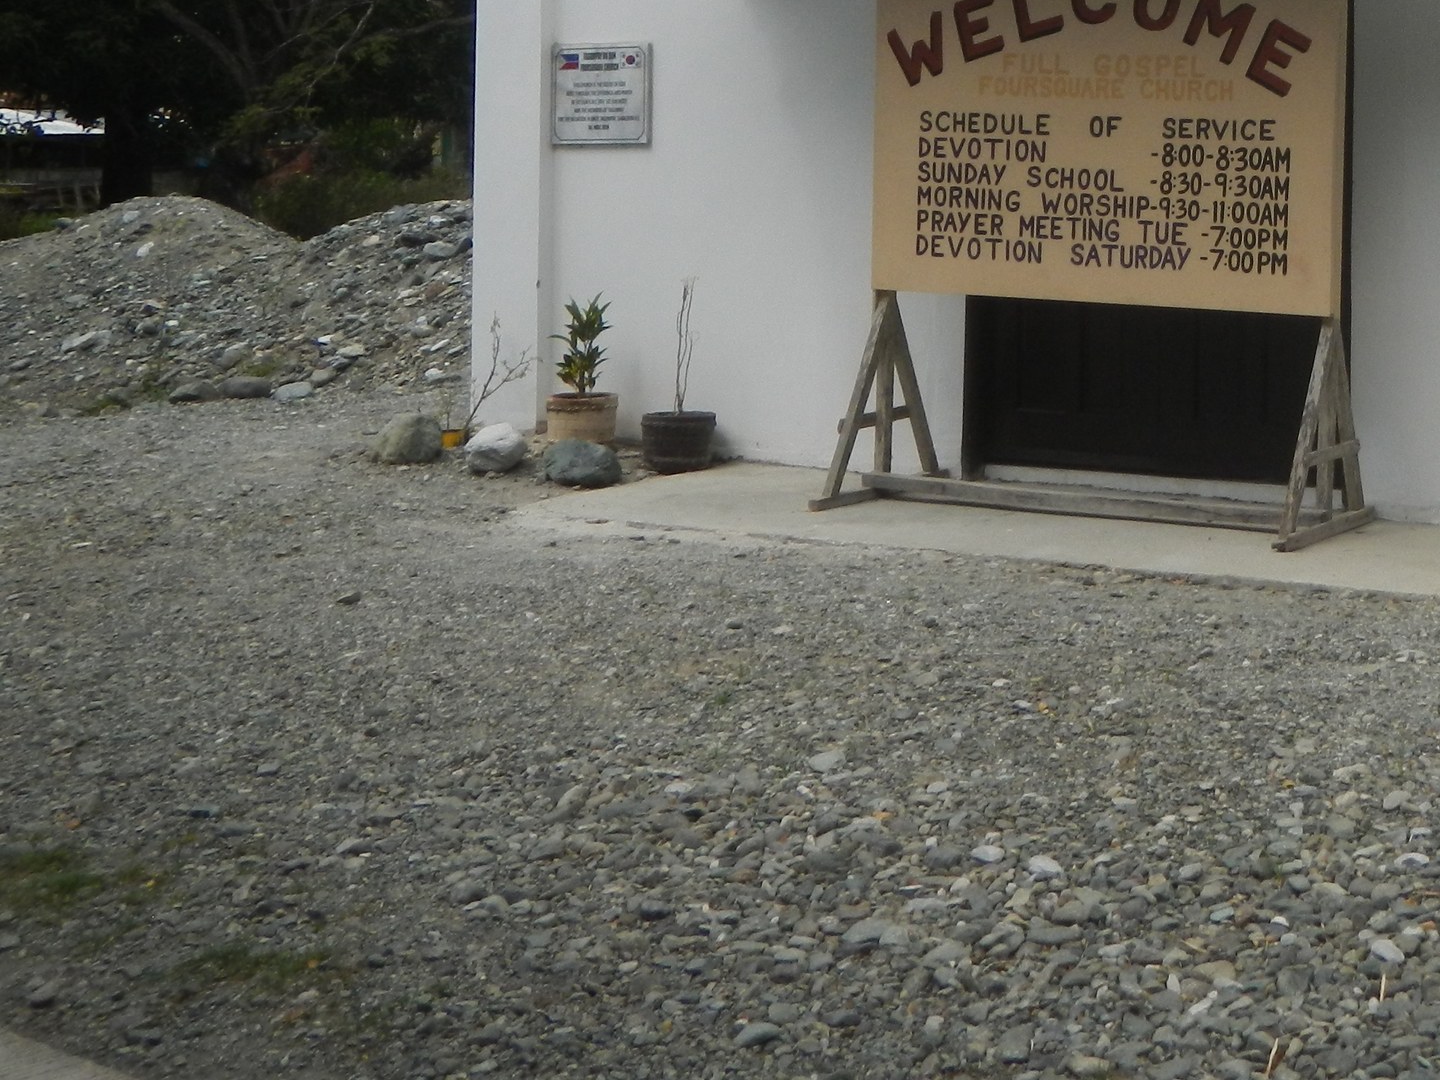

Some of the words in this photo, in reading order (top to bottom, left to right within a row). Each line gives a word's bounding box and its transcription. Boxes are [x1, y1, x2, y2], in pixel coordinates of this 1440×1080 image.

[1001, 53, 1070, 76] FULL
[1093, 55, 1206, 80] GOSPEL
[978, 75, 1124, 100] FOURSQUARE
[1139, 79, 1235, 102] CHURCH
[919, 110, 1051, 136] SCHEDULE
[1089, 115, 1122, 138] OF
[1162, 117, 1276, 141] SERVICE
[918, 136, 1047, 163] DEVOTION
[917, 160, 1007, 186] SUNDAY
[1026, 165, 1125, 192] SCHOOL
[917, 185, 1021, 212] MORNING
[916, 209, 1004, 236] PRAYER
[1019, 214, 1121, 242] MEETING
[1137, 219, 1188, 246] TUE
[915, 233, 1043, 264] DEVOTION
[1070, 242, 1191, 271] SATURDAY
